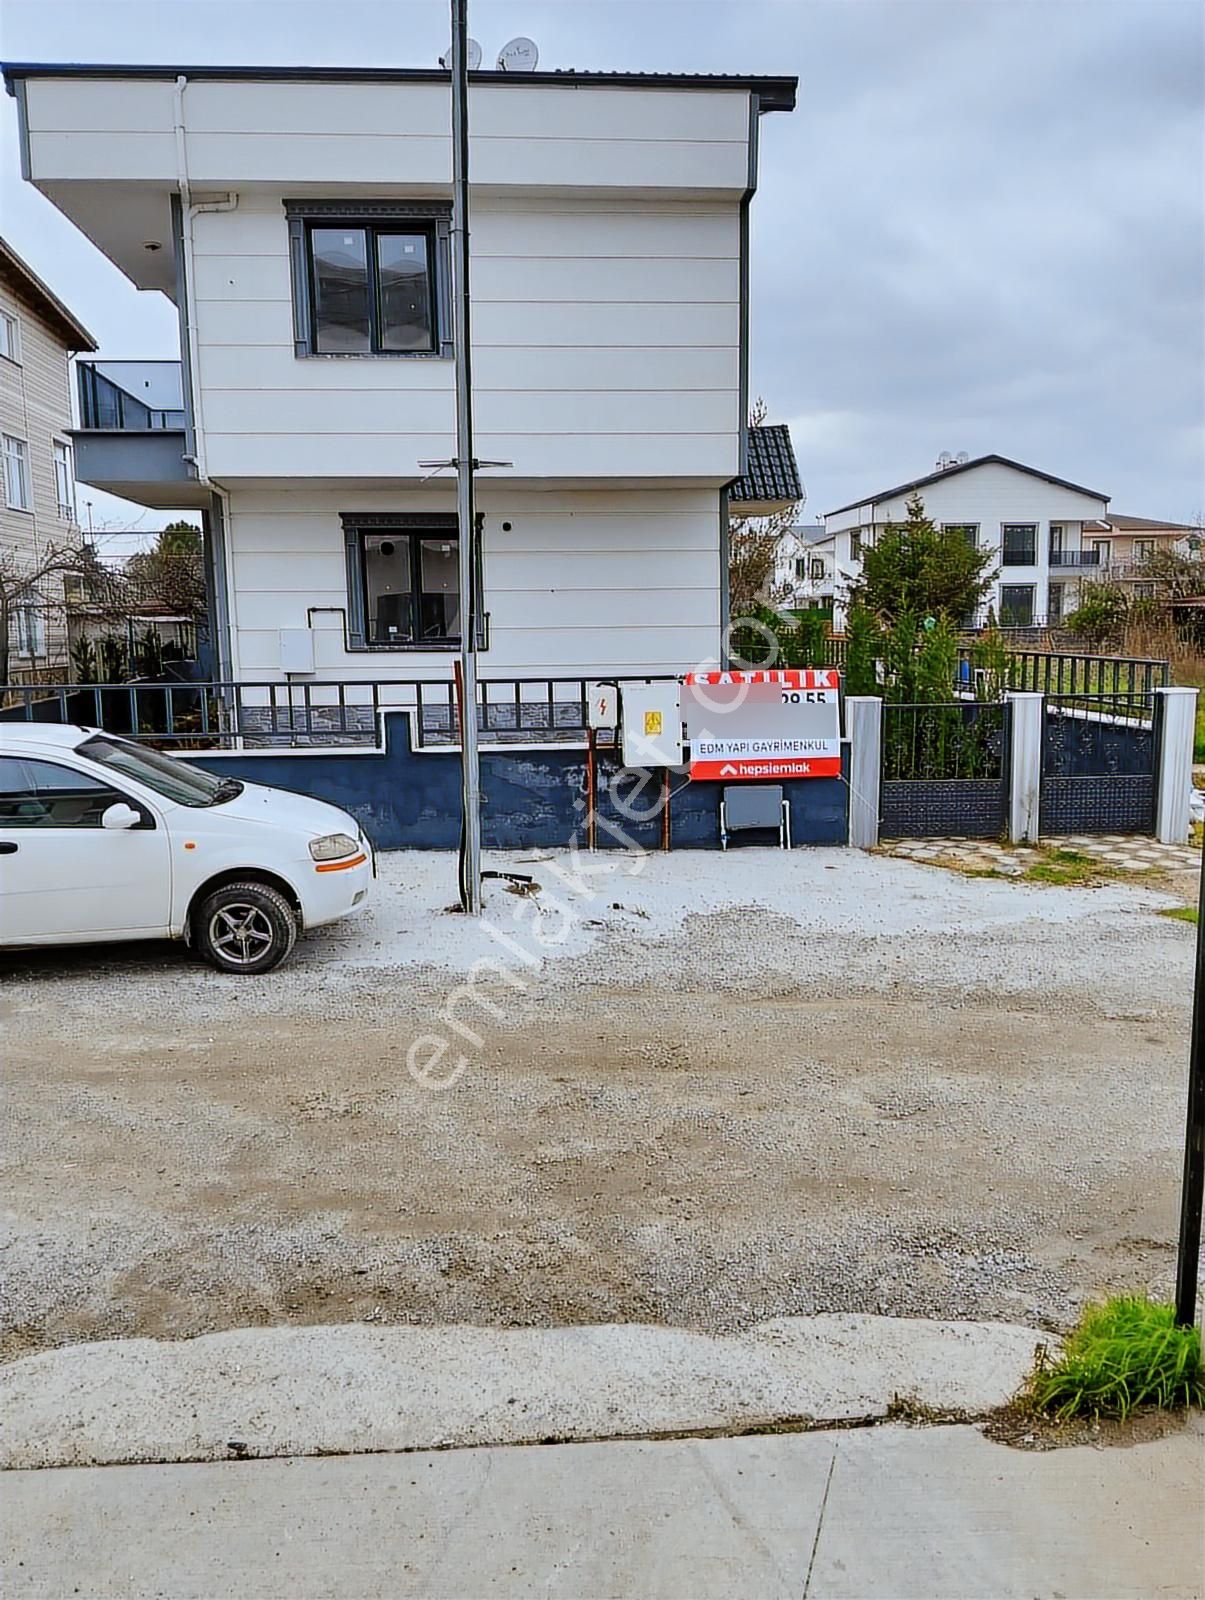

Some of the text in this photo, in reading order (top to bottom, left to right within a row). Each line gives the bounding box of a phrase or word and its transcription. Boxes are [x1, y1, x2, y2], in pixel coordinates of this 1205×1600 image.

[694, 670, 832, 688] SATILIK
[700, 739, 829, 754] EDM YAPI GAYRİMENKUL
